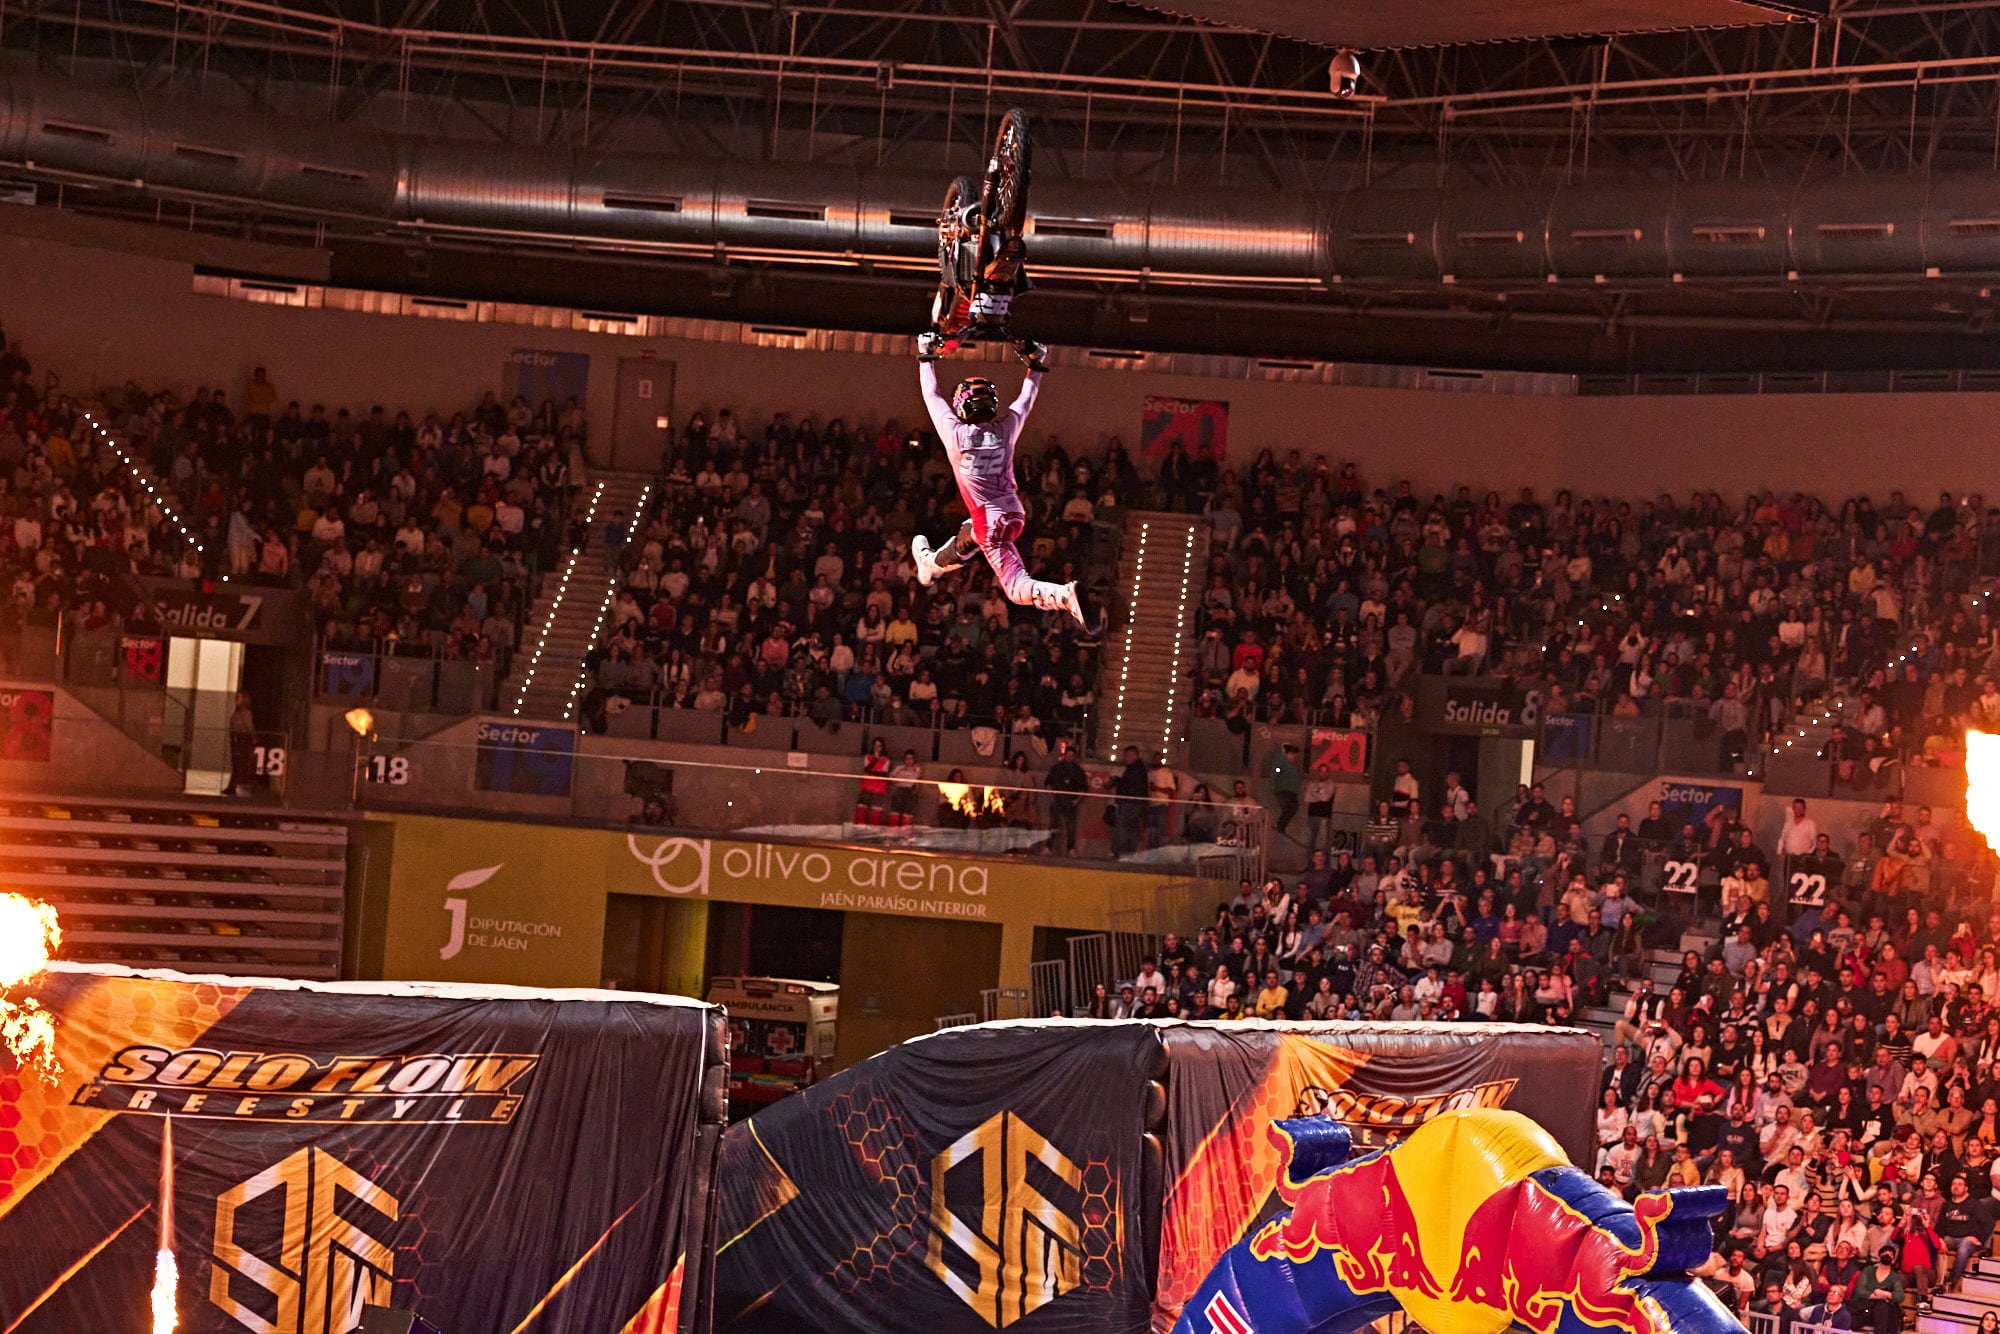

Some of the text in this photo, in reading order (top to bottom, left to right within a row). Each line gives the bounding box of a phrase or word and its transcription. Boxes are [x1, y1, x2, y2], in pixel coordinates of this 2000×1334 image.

[154, 595, 263, 630] Salida 7
[122, 637, 155, 649] Sector
[323, 654, 360, 666] Sector
[1444, 689, 1541, 726] Salida 8
[1545, 714, 1575, 727] Sector
[478, 724, 540, 744] Sector
[1312, 729, 1348, 741] Sector
[254, 747, 285, 776] 18
[1311, 728, 1367, 772] 20
[373, 756, 409, 785] 18
[1661, 783, 1713, 804] Sector
[723, 843, 831, 883] olivo
[849, 857, 988, 896] arena
[1663, 861, 1698, 894] 22
[1789, 872, 1826, 906] 22
[820, 891, 986, 917] JAÉN PARAÍSO INTERIOR
[468, 934, 489, 947] DE
[469, 917, 561, 937] DIPUTACIÓN
[725, 1000, 795, 1013] AMBULANCIA
[104, 1049, 532, 1093] SOLO FLOW
[76, 1084, 516, 1119] FREESTYLE
[1301, 1087, 1403, 1125] SOLO
